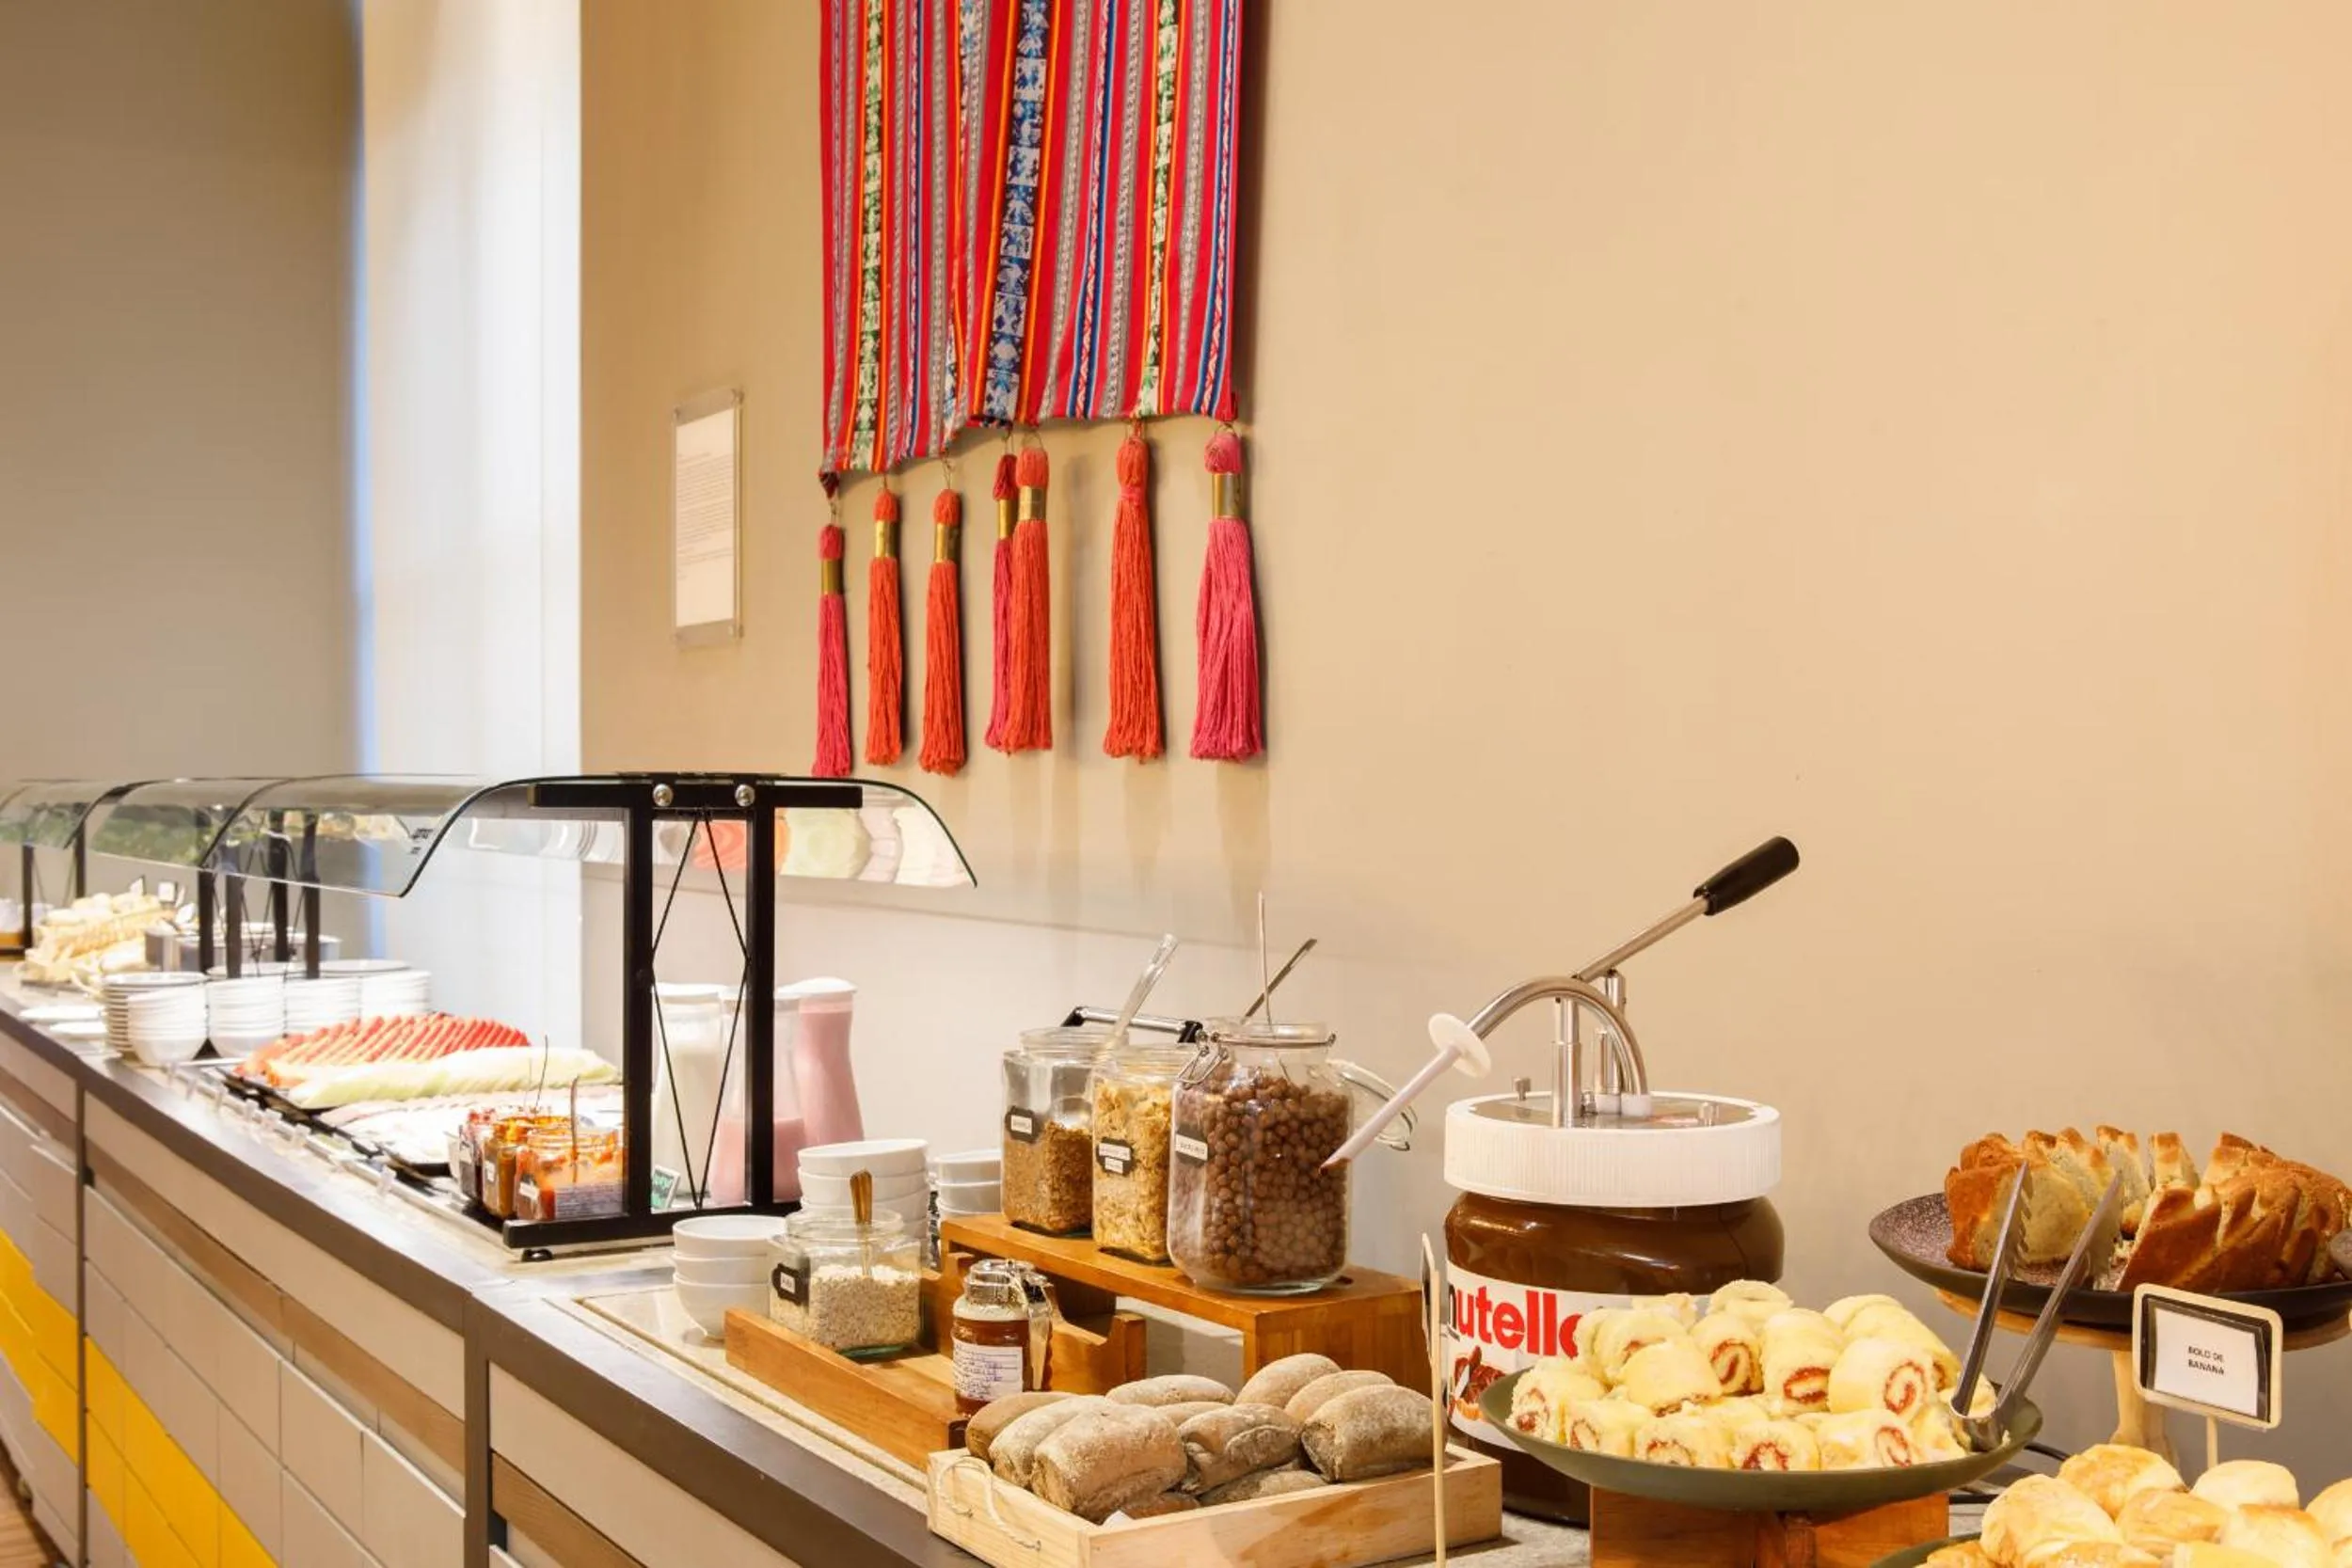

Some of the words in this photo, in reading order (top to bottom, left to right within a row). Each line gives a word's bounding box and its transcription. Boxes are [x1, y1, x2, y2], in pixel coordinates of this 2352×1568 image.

[2188, 1345, 2211, 1358] BOLO
[2212, 1352, 2223, 1362] DE
[2188, 1358, 2224, 1374] BANANA
